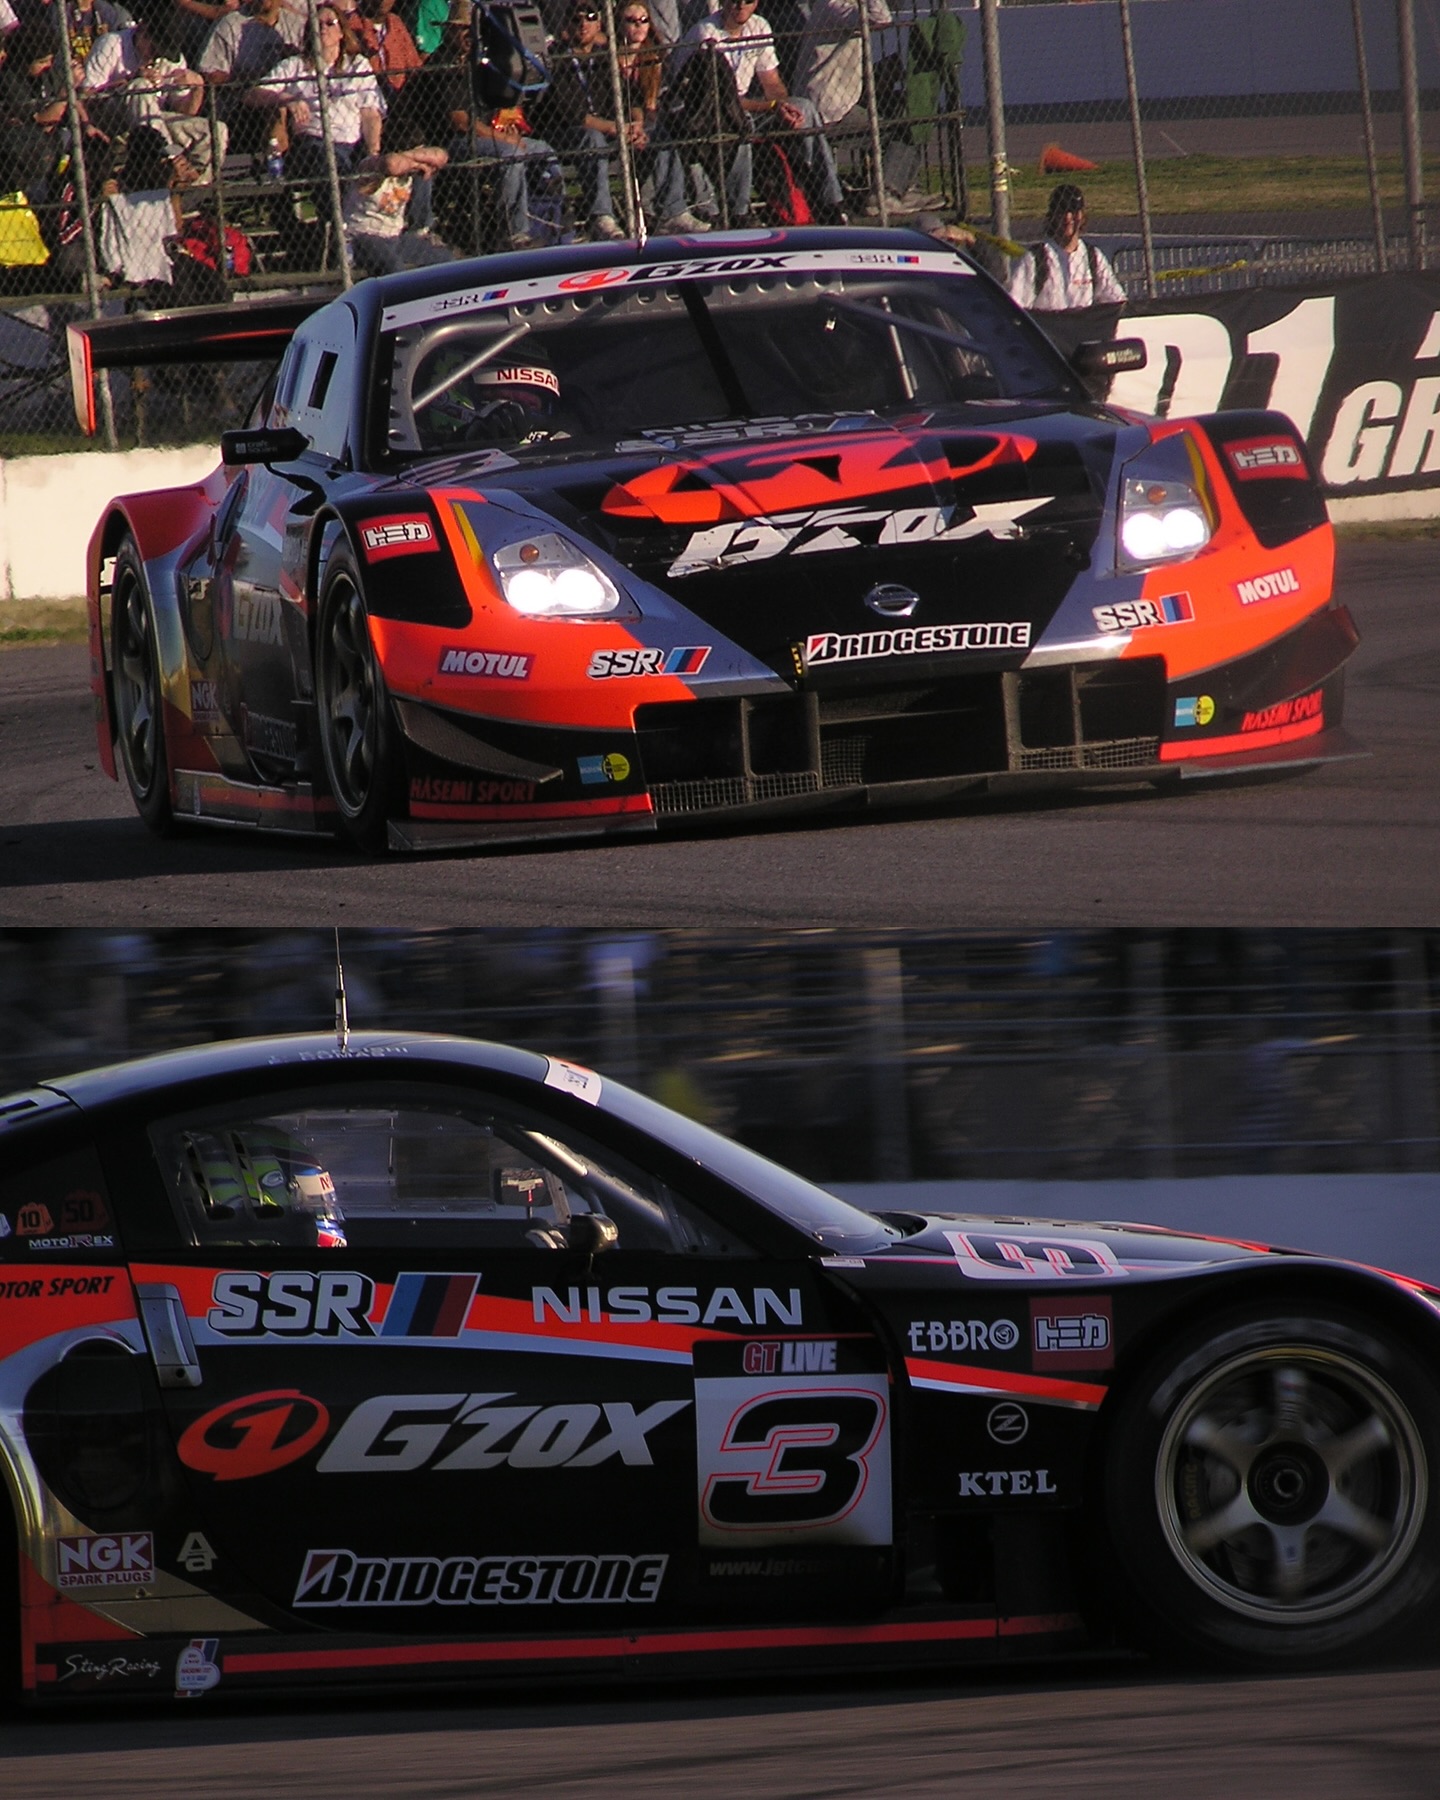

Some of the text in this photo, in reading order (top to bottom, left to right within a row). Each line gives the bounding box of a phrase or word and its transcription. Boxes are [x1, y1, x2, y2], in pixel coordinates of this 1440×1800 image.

[1232, 445, 1300, 470] トミカ
[363, 521, 432, 549] トミカ
[1237, 568, 1299, 604] MOTUL
[1092, 599, 1162, 632] SSR
[808, 623, 1031, 665] BRIDGESTONE
[441, 650, 530, 678] MOTUL
[587, 647, 664, 680] SSR
[191, 681, 219, 710] NGK
[409, 775, 537, 802] HASEMI SPORT
[20, 1210, 41, 1229] 10
[64, 1200, 94, 1223] 50
[48, 1276, 115, 1297] SPORT
[207, 1271, 377, 1337] SSR
[531, 1286, 803, 1327] NISSAN
[907, 1318, 1020, 1352] EBBRO
[1034, 1313, 1110, 1352] トミカ
[705, 1392, 883, 1527] 3
[958, 1469, 1057, 1497] KTEL
[59, 1535, 151, 1574] NGK
[60, 1572, 151, 1586] SPARK PLUGS
[292, 1549, 670, 1608] BRIDGESTONE
